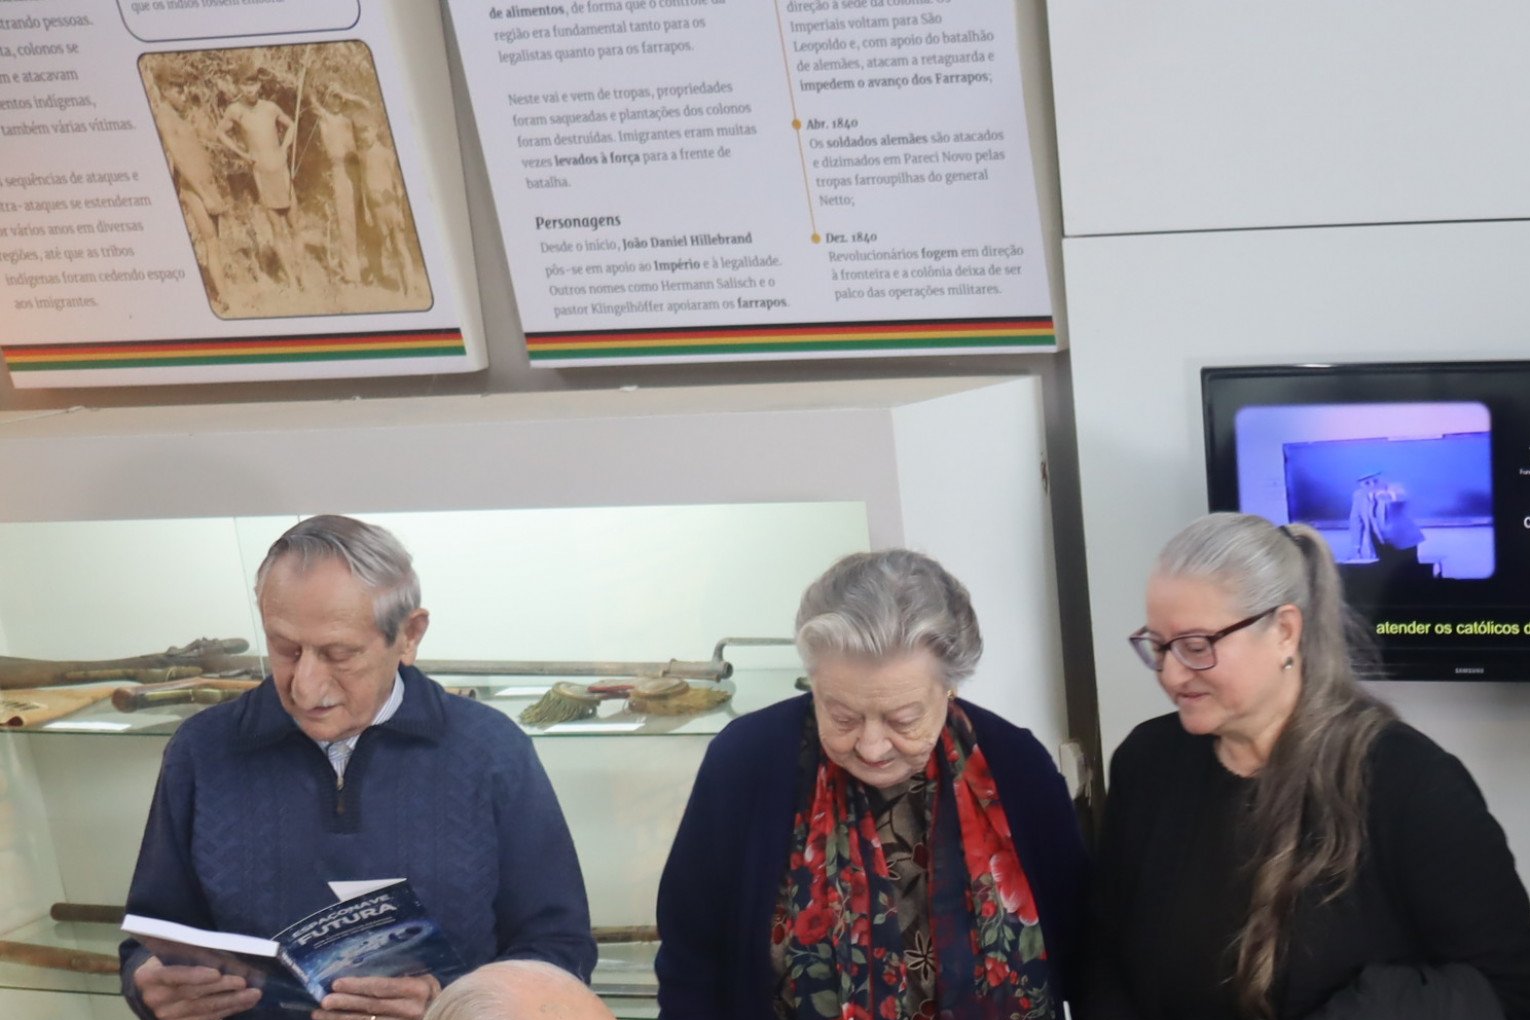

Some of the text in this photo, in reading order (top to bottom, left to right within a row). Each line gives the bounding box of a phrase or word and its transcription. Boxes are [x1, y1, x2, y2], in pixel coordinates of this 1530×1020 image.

[489, 0, 623, 19] de alimentos, de forma
[493, 18, 706, 44] região era fundamental tanto para os
[789, 12, 943, 35] Imperiais voltam para São
[15, 41, 65, 58] colonos
[792, 29, 995, 55] Leopoldo e, com apoio do batalhão
[497, 40, 694, 66] legalistas quanto para os farrapos.
[796, 50, 995, 72] de alemães, atacam a retaguarda e
[21, 70, 79, 83] atacavam
[799, 72, 992, 94] impedem o avanço dos Farrapos;
[507, 80, 734, 106] Neste vai e vem de tropas, propriedades
[512, 102, 752, 127] foram saqueadas e plantações dos colonos
[806, 117, 859, 130] Abr. 1840
[0, 120, 50, 137] também
[50, 119, 88, 134] várias
[517, 123, 758, 148] foram destruídas. Imigrantes eram muitas
[809, 129, 1005, 150] Os soldados alemães são atacados
[521, 145, 731, 169] vezes levados à força para a frente de
[812, 148, 1006, 169] e dizimados em Pareci Novo pelas
[525, 175, 571, 190] batalha.
[815, 168, 989, 190] tropas farroupilhas do general
[818, 194, 855, 207] Netto;
[535, 215, 621, 231] Personagens
[540, 231, 753, 254] Desde o início, João Daniel Hillebrand
[851, 231, 878, 244] 1840
[828, 244, 1024, 263] Revolucionários fogem em direção
[585, 264, 603, 275] em
[605, 260, 637, 277] apoio
[638, 262, 652, 272] ao
[653, 258, 701, 274] Império
[702, 260, 710, 269] e
[711, 256, 719, 269] à
[720, 254, 782, 272] legalidade.
[831, 263, 1022, 281] à fronteira e a colônia deixa de ser
[549, 285, 587, 296] Outros
[588, 284, 627, 295] nomes
[627, 282, 659, 293] como
[660, 280, 715, 292] Hermann
[758, 278, 766, 288] e
[767, 278, 776, 288] o
[834, 283, 1002, 302] palco das operações militares.
[553, 305, 589, 319] pastor
[666, 299, 720, 315] apoiaram
[721, 300, 736, 310] os
[737, 296, 789, 311] farrapos.
[1376, 621, 1431, 635] atender
[1434, 623, 1452, 635] os
[1456, 620, 1520, 635] católicos
[297, 903, 398, 946] FUTURA
